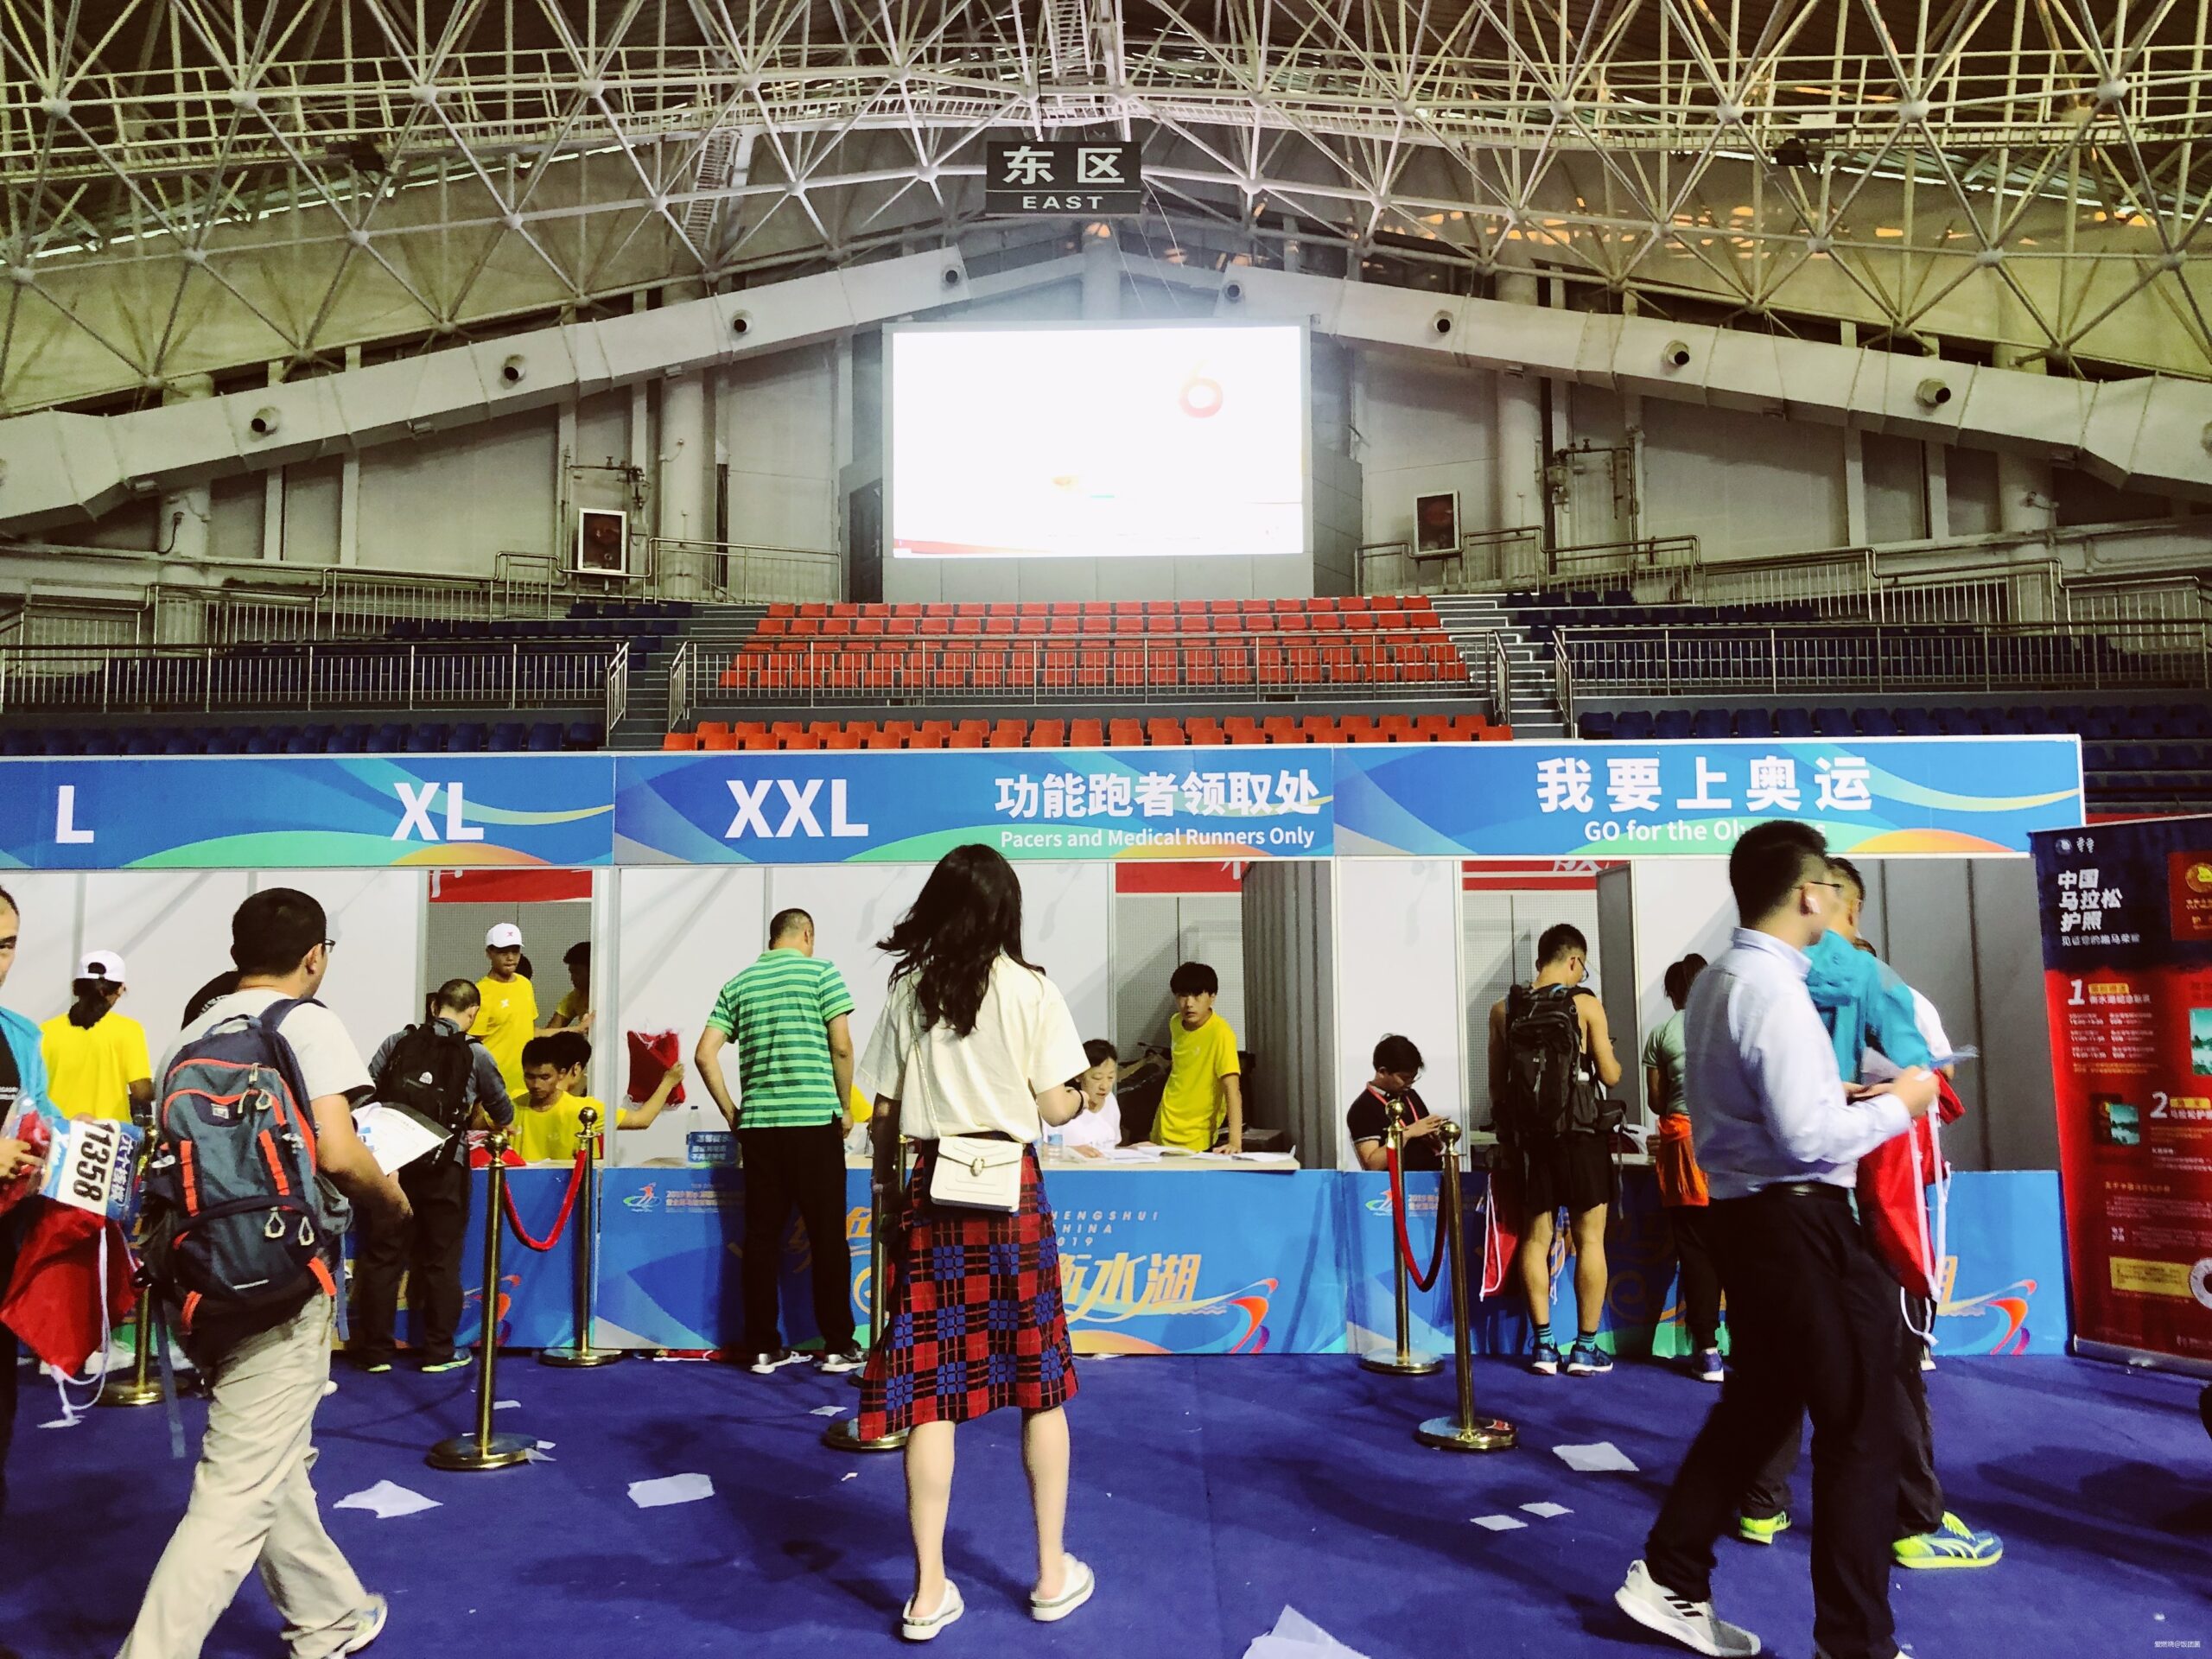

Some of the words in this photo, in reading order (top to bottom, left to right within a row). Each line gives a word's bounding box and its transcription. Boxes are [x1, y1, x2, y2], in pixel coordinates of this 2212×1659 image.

[1002, 145, 1125, 185] 东区
[1022, 195, 1103, 209] EAST
[995, 769, 1321, 818] 功能跑者领取处
[1535, 756, 1872, 813] 我要上奥运
[56, 785, 94, 843] L
[391, 782, 485, 841] XL
[724, 779, 869, 838] XXL
[1001, 830, 1062, 848] Pacers
[1067, 828, 1103, 847] and
[1108, 827, 1181, 847] Medical
[1185, 828, 1265, 846] Runners
[1268, 825, 1314, 849] Only
[1584, 821, 1620, 842] GO
[1626, 818, 1661, 842] for
[1666, 818, 1708, 842] the
[2057, 868, 2100, 891] 中国
[2058, 887, 2124, 912] 马拉松
[2060, 910, 2103, 933] 护照
[2068, 978, 2085, 1006] 1
[2150, 1091, 2168, 1119] 2
[73, 1122, 115, 1201] 11358
[1052, 1211, 1159, 1221] HENGSHUI
[1052, 1224, 1113, 1234] HINA
[1057, 1236, 1094, 1247] 019
